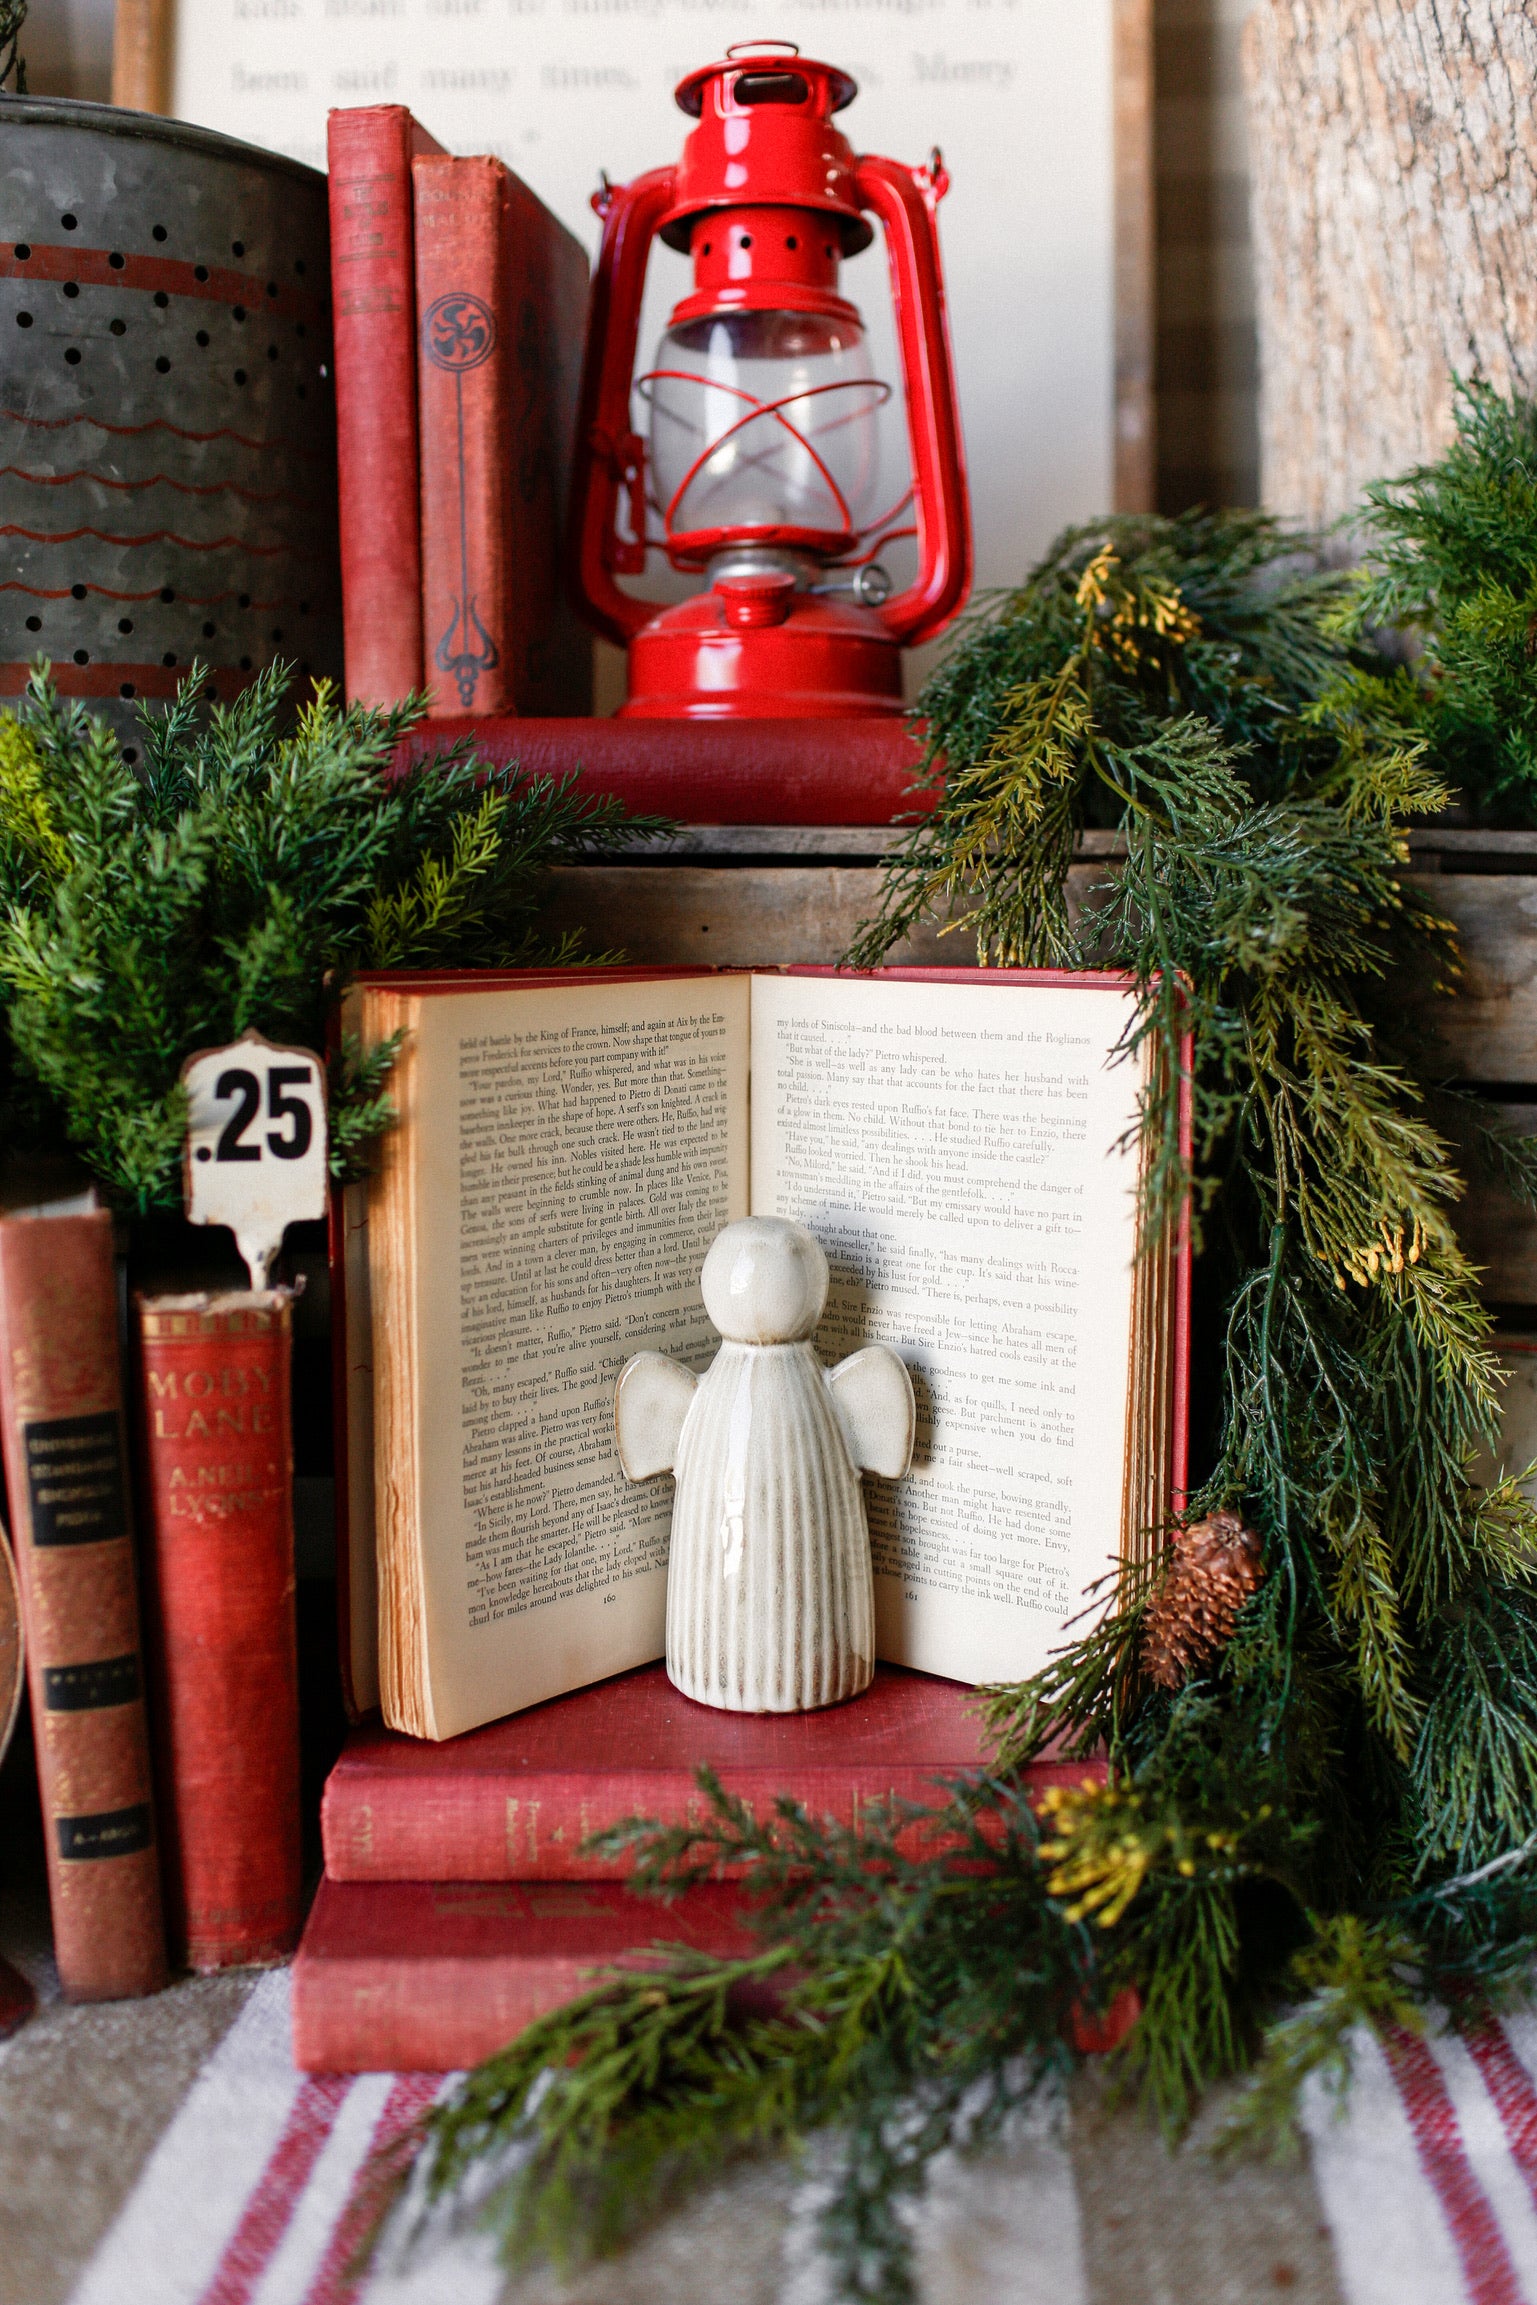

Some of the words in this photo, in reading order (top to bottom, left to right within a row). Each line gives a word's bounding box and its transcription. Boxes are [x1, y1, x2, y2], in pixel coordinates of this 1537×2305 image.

[540, 1031, 558, 1042] King
[560, 1029, 569, 1038] of
[571, 1028, 598, 1037] France,
[600, 1022, 629, 1034] himself;
[631, 1020, 645, 1031] and
[646, 1019, 665, 1032] again
[667, 1019, 674, 1027] at
[676, 1017, 688, 1026] Aix
[689, 1016, 697, 1027] by
[699, 1014, 710, 1024] the
[776, 1020, 789, 1029] my
[791, 1018, 809, 1028] lords
[810, 1019, 819, 1029] of
[879, 1024, 893, 1033] the
[896, 1025, 911, 1035] bad
[914, 1026, 937, 1036] blood
[940, 1027, 976, 1038] between
[979, 1030, 1003, 1040] them
[1006, 1031, 1023, 1041] and
[1027, 1032, 1042, 1042] the
[1045, 1033, 1090, 1045] Roglianos
[537, 1101, 559, 1111] What
[562, 1097, 577, 1107] had
[579, 1091, 617, 1107] happened
[618, 1092, 626, 1100] to
[629, 1089, 650, 1099] Pietro
[653, 1086, 660, 1096] di
[663, 1083, 686, 1094] Donati
[688, 1083, 705, 1091] came
[707, 1081, 715, 1089] to
[716, 1078, 727, 1088] the
[196, 1067, 312, 1162] .25
[785, 1093, 812, 1105] Pietro's
[813, 1096, 830, 1106] dark
[832, 1100, 849, 1110] eyes
[851, 1100, 874, 1110] rested
[877, 1104, 898, 1114] upon
[901, 1103, 932, 1114] Ruffio's
[934, 1106, 946, 1116] fat
[949, 1107, 968, 1117] face.
[971, 1109, 999, 1120] There
[1022, 1113, 1037, 1123] the
[1040, 1114, 1086, 1129] beginning
[784, 1142, 806, 1154] Ruffio
[807, 1145, 832, 1157] looked
[833, 1151, 866, 1161] worried.
[869, 1152, 890, 1163] Then
[892, 1155, 903, 1164] he
[904, 1156, 928, 1167] shook
[930, 1158, 943, 1168] his
[945, 1159, 967, 1170] head.
[781, 1168, 823, 1181] townsman's
[824, 1174, 861, 1189] meddling
[863, 1178, 871, 1187] in
[873, 1179, 886, 1189] the
[888, 1180, 913, 1192] affairs
[913, 1183, 924, 1193] of
[925, 1184, 939, 1194] the
[941, 1187, 986, 1198] gentlefolk.
[521, 1226, 545, 1238] ample
[547, 1221, 584, 1233] substitute
[586, 1217, 597, 1227] for
[599, 1213, 622, 1227] gentle
[625, 1209, 645, 1220] birth.
[647, 1206, 658, 1216] All
[660, 1206, 676, 1214] over
[678, 1200, 693, 1211] Italy
[695, 1197, 706, 1207] the
[807, 1222, 836, 1236] thought
[838, 1226, 860, 1236] about
[864, 1228, 877, 1238] that
[879, 1232, 896, 1240] one.
[912, 1362, 926, 1372] the
[916, 1366, 966, 1378] goodness
[969, 1371, 978, 1380] to
[980, 1374, 994, 1384] get
[149, 1367, 272, 1400] MOBY
[1014, 1380, 1037, 1388] some
[1040, 1381, 1055, 1391] ink
[1058, 1384, 1075, 1394] and
[155, 1405, 275, 1438] LANE
[471, 1427, 495, 1438] Pietro
[497, 1416, 528, 1432] clapped
[538, 1409, 558, 1422] hand
[560, 1407, 580, 1418] upon
[583, 1397, 610, 1411] Ruffio's
[932, 1405, 956, 1415] geese.
[960, 1407, 975, 1418] But
[979, 1414, 1025, 1426] parchment
[1029, 1419, 1037, 1428] is
[1040, 1422, 1074, 1432] another
[462, 1470, 486, 1482] merce
[489, 1466, 497, 1475] at
[500, 1462, 512, 1472] his
[515, 1458, 532, 1468] feet.
[535, 1452, 546, 1462] Of
[548, 1448, 575, 1459] course,
[577, 1438, 611, 1452] Abraham
[463, 1494, 488, 1507] Isaac's
[489, 1481, 545, 1501] establishment.
[918, 1477, 934, 1487] and
[934, 1480, 955, 1490] took
[956, 1483, 970, 1493] the
[972, 1488, 998, 1500] purse,
[1000, 1490, 1032, 1507] bowing
[1034, 1500, 1071, 1514] grandly.
[465, 1536, 486, 1548] made
[488, 1531, 509, 1542] them
[510, 1519, 539, 1536] flourish
[541, 1511, 569, 1527] beyond
[571, 1510, 584, 1519] any
[586, 1504, 594, 1514] of
[596, 1498, 619, 1511] Isaac's
[620, 1493, 648, 1505] dreams.
[649, 1486, 660, 1497] Of
[661, 1483, 673, 1493] the
[468, 1612, 489, 1626] churl
[492, 1610, 504, 1619] for
[506, 1603, 527, 1614] miles
[529, 1591, 556, 1607] around
[559, 1589, 573, 1598] was
[575, 1574, 609, 1593] delighted
[621, 1568, 632, 1578] his
[634, 1561, 651, 1574] soul.
[603, 1592, 616, 1603] 160
[903, 1573, 927, 1584] points
[928, 1578, 937, 1586] to
[938, 1581, 959, 1594] carry
[961, 1584, 975, 1595] the
[977, 1587, 991, 1598] ink
[992, 1592, 1013, 1603] well.
[1016, 1595, 1042, 1610] Ruffio
[1043, 1605, 1068, 1616] could
[904, 1590, 918, 1601] 161
